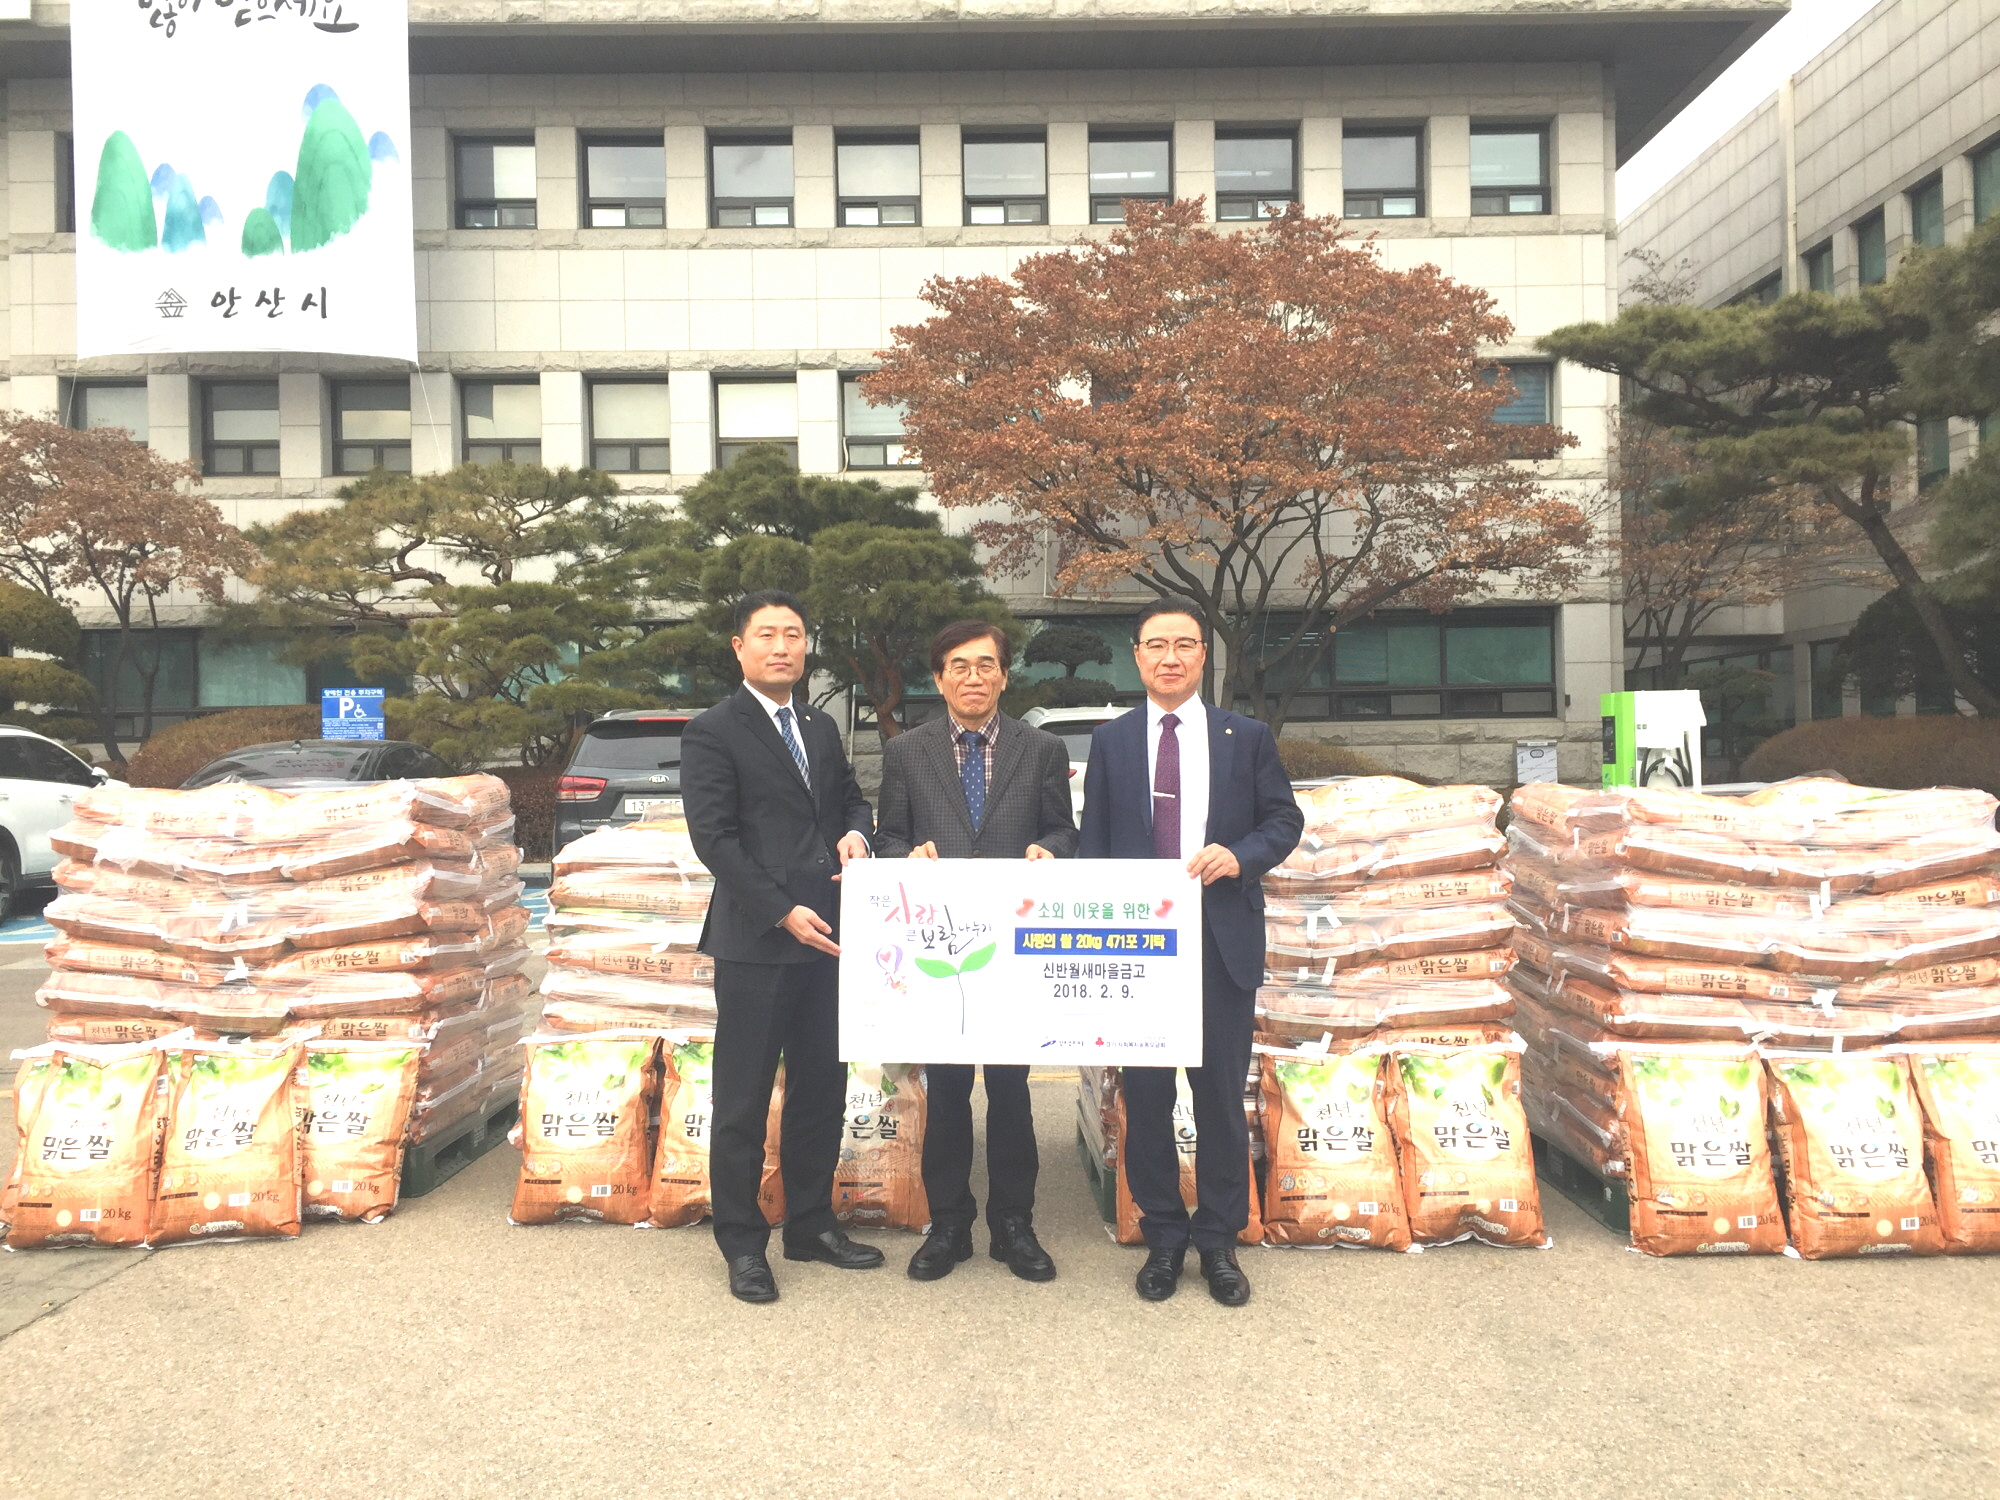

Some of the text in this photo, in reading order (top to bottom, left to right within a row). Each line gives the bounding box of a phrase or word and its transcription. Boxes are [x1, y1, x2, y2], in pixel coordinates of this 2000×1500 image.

[211, 287, 328, 319] 안산시
[339, 698, 354, 718] P
[870, 881, 939, 925] 작은 사랑
[1038, 902, 1151, 919] 소외 이웃을 위한
[906, 905, 992, 955] 큰 보람 나누기
[1023, 933, 1165, 950] 사랑의 쌀 20kg 471포 기탁
[1043, 962, 1145, 979] 신반월새마을금고
[1419, 957, 1469, 975] 맑은쌀
[1054, 984, 1134, 998] 2018. 2. 9.
[850, 1091, 883, 1109] 천년
[542, 1113, 619, 1137] 맑은쌀
[842, 1114, 899, 1139] 은쌀
[1297, 1126, 1375, 1152] 맑은쌀
[1434, 1123, 1511, 1150] 맑은쌀
[42, 1135, 114, 1160] 맑은쌀
[1670, 1140, 1752, 1167] 맑은쌀
[1830, 1143, 1910, 1168] 맑은쌀
[252, 1191, 279, 1203] 20 kg
[354, 1182, 380, 1194] 20 kg
[613, 1184, 637, 1196] 20 kg
[103, 1208, 131, 1220] 20 kg
[1380, 1203, 1401, 1216] 20 kg
[1519, 1201, 1529, 1210] 20
[1758, 1215, 1778, 1226] 20 kg
